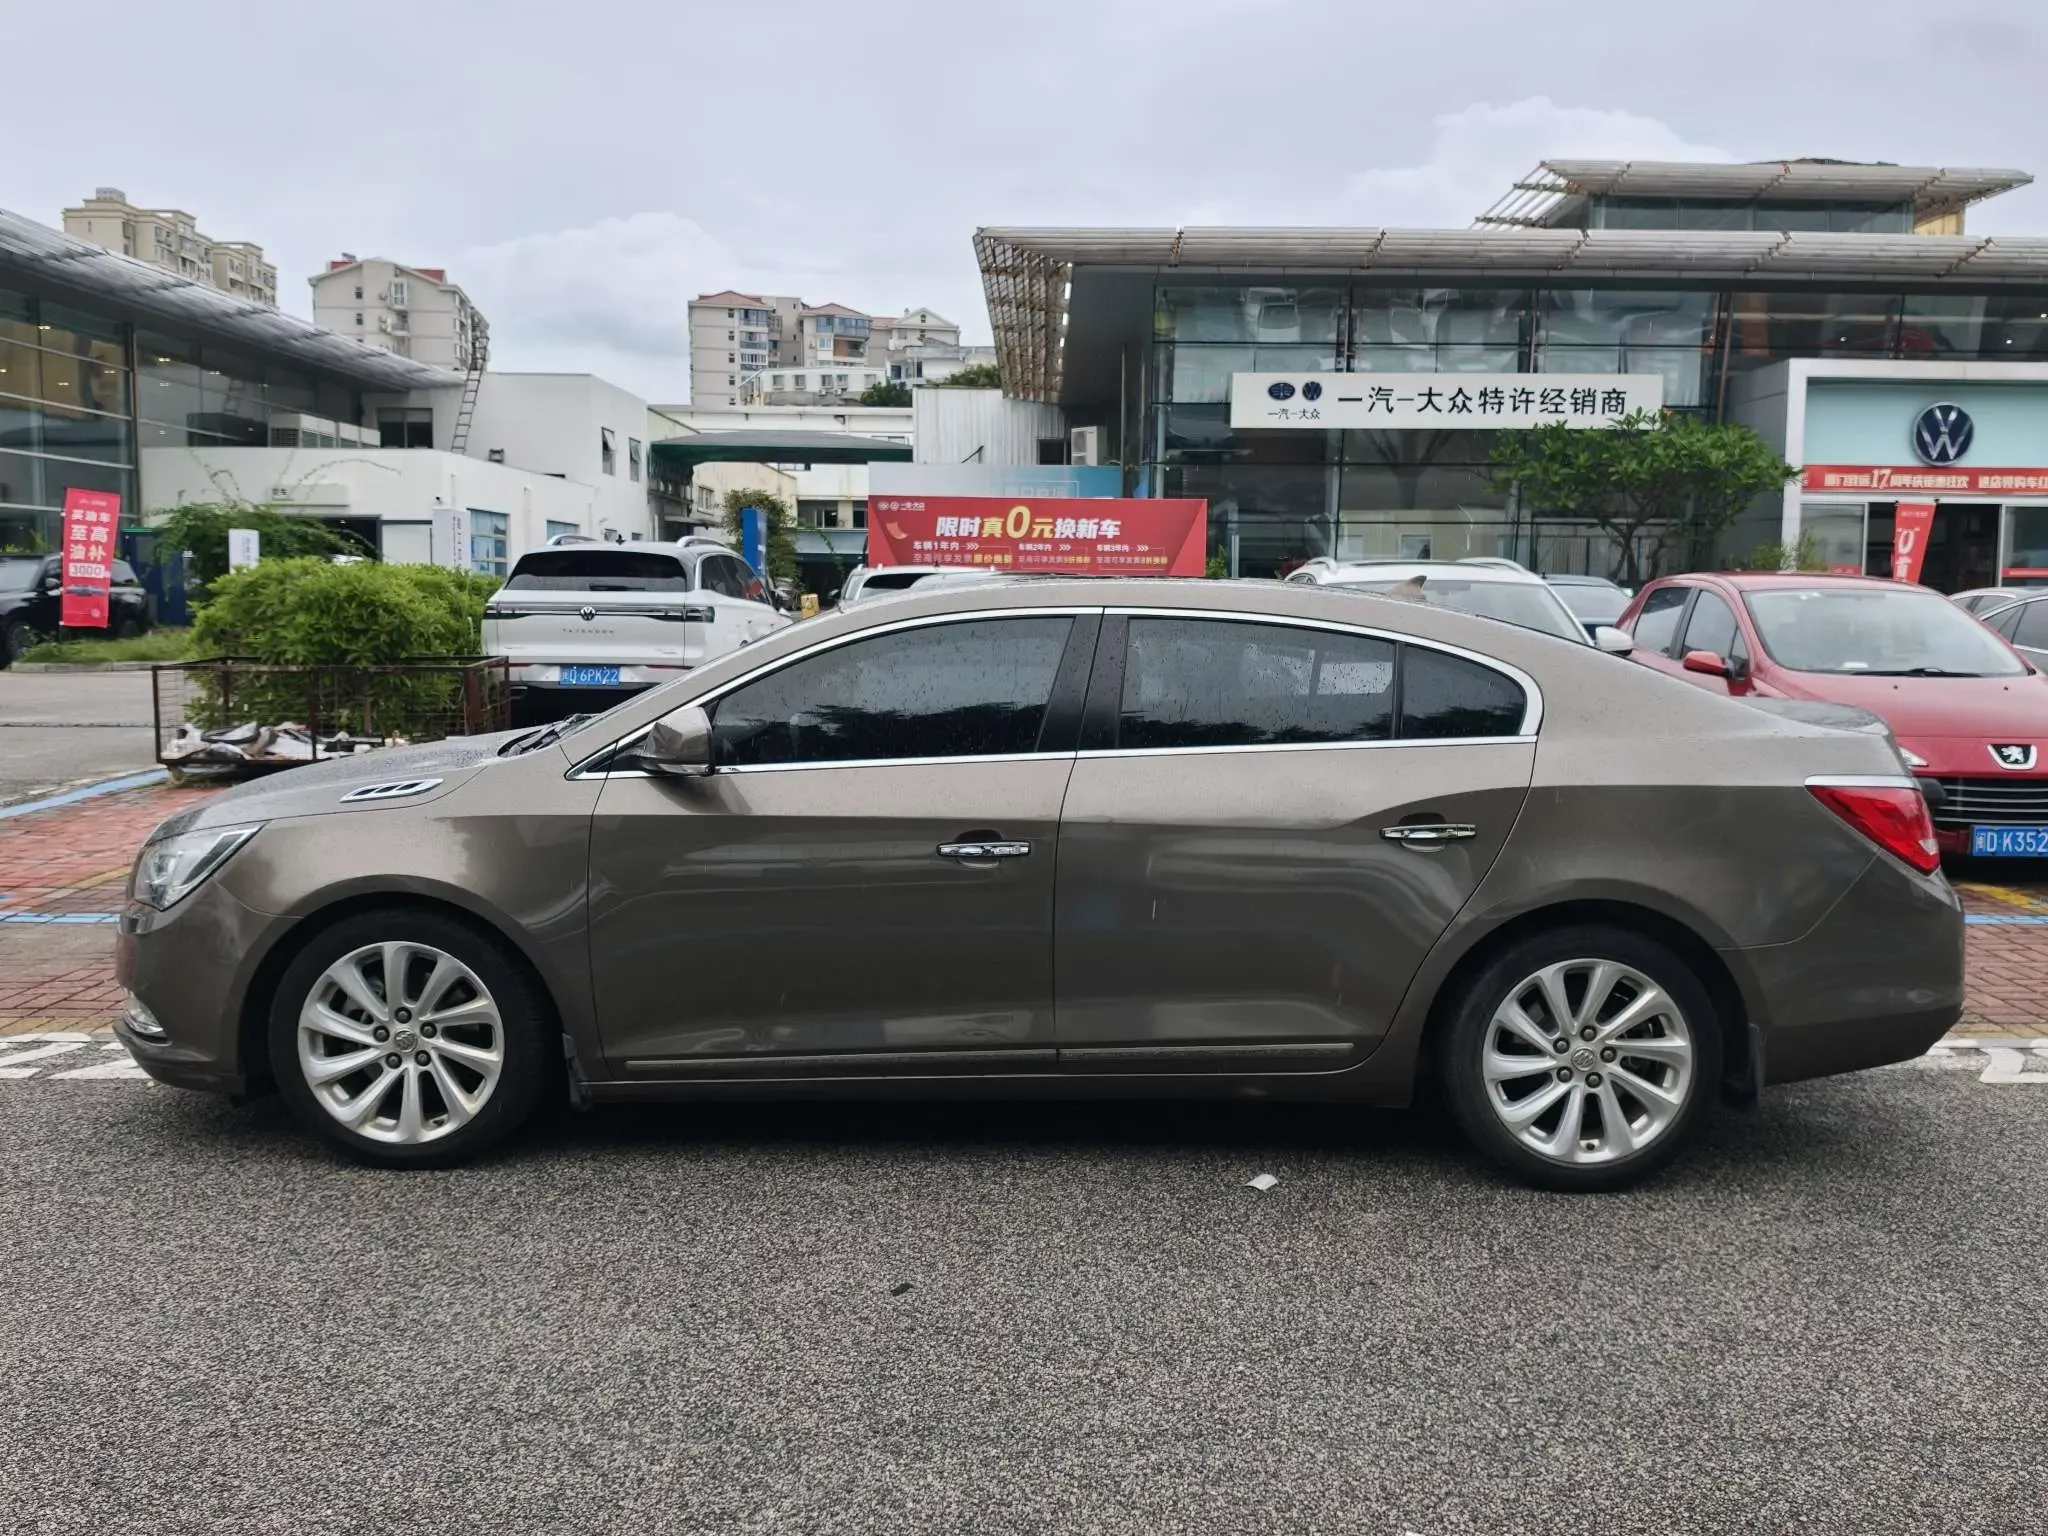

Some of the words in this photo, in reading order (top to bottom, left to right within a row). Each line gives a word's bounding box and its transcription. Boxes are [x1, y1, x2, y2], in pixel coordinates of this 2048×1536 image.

[935, 505, 1122, 540] 限时真0元换新车
[70, 524, 110, 543] 至高
[69, 543, 107, 562] 油补
